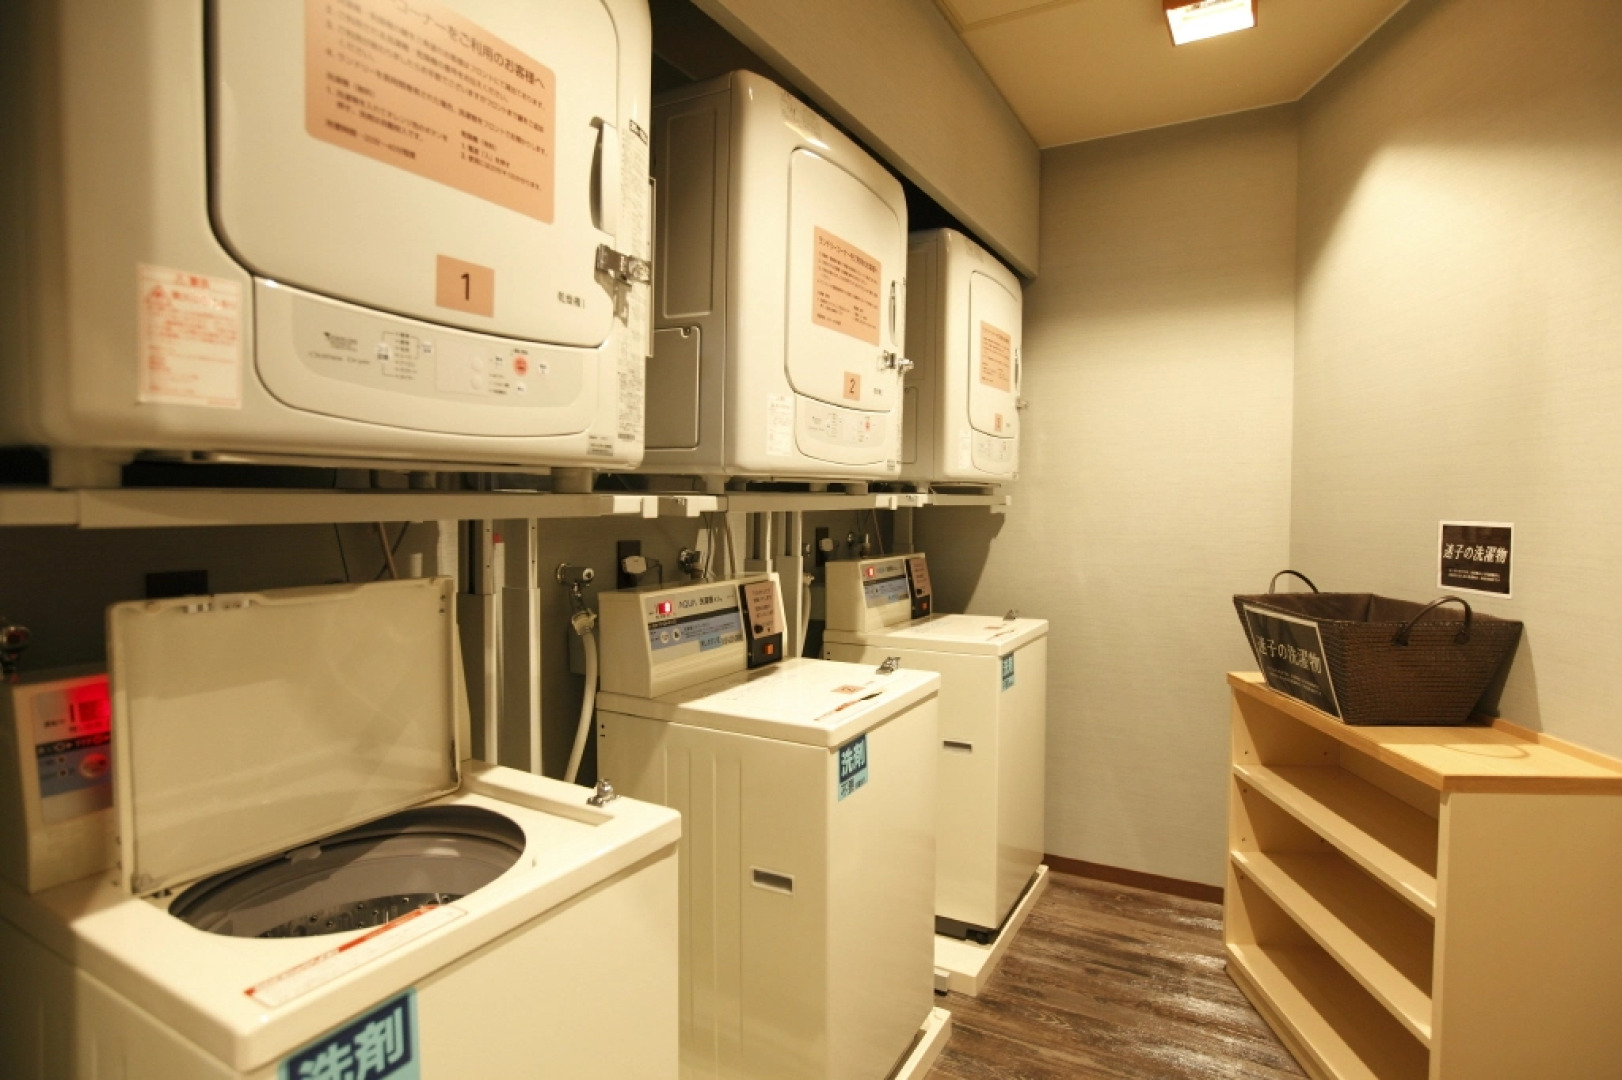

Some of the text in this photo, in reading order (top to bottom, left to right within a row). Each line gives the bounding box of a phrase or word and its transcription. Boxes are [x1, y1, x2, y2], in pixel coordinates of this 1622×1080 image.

[459, 272, 471, 302] 1
[848, 378, 856, 394] 2
[1443, 543, 1508, 564] 迷子の洗濯物
[1256, 635, 1321, 674] 迷子の洗濯物
[841, 739, 865, 777] 洗剤
[298, 1006, 405, 1080] 洗剤
